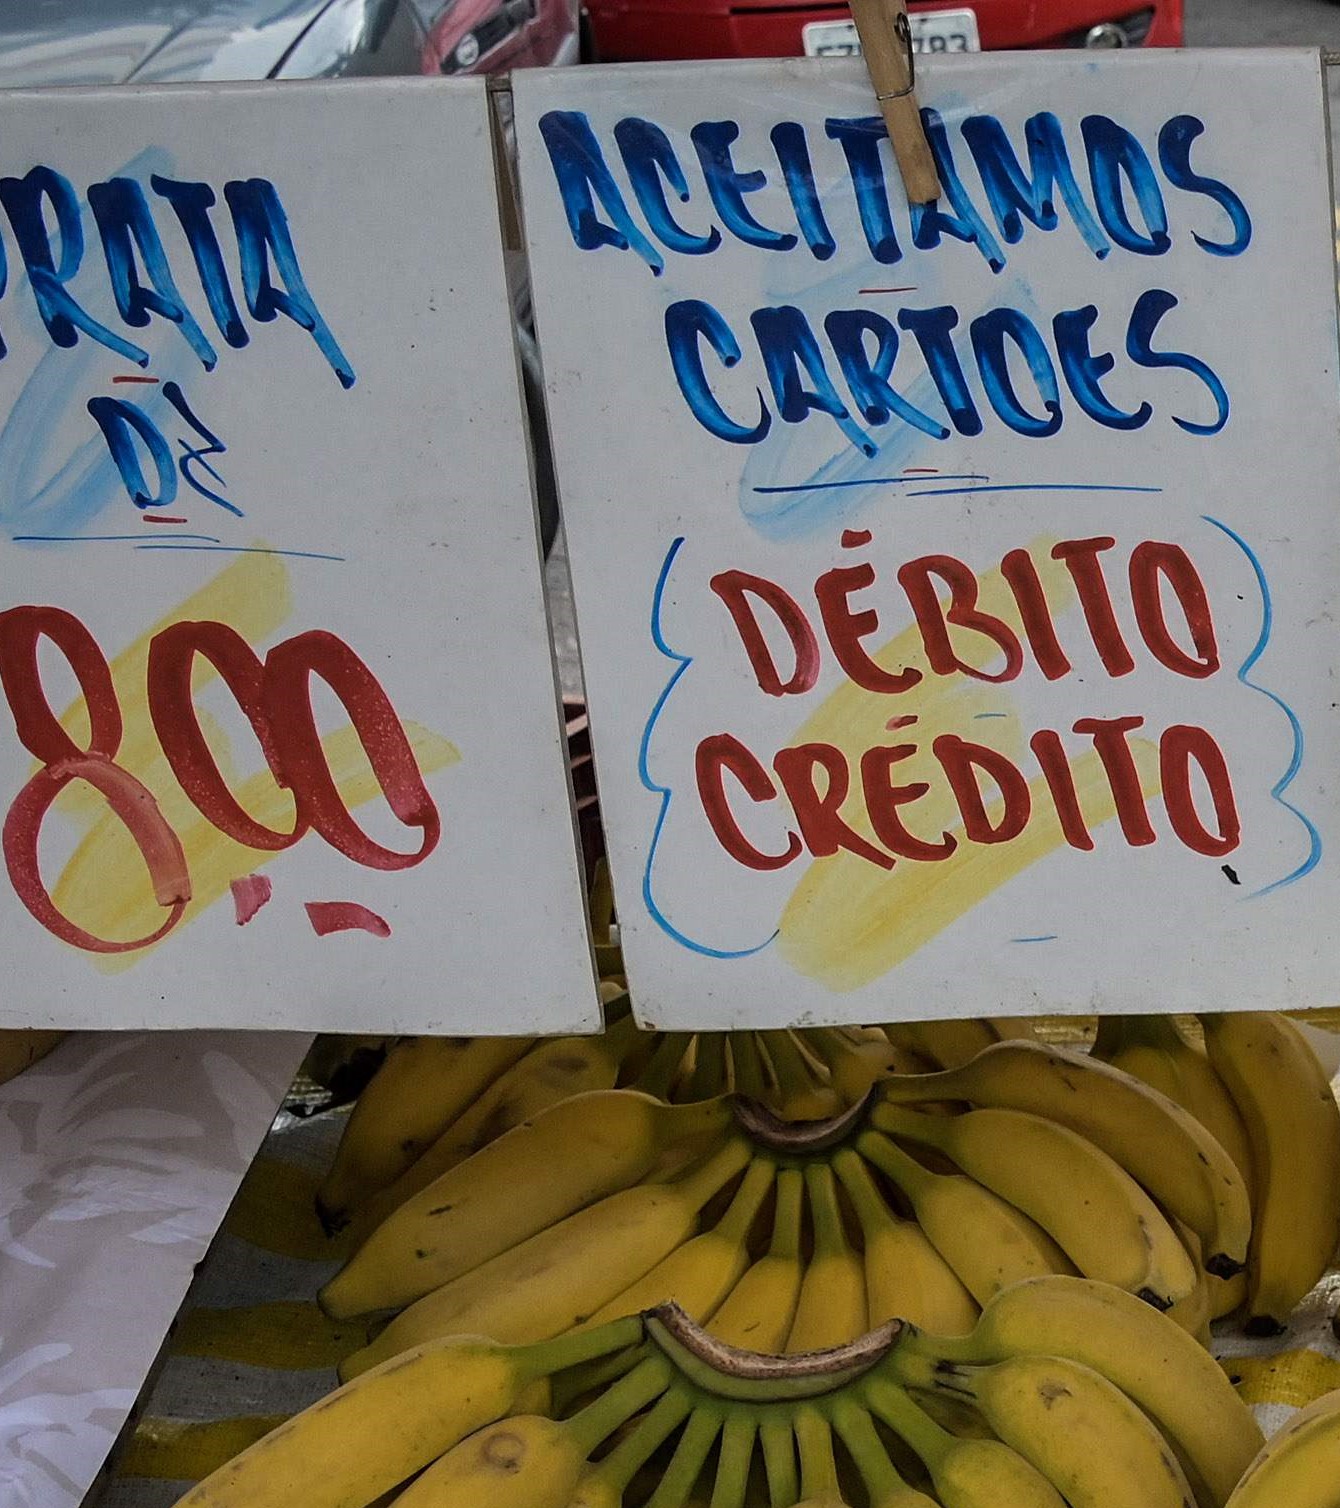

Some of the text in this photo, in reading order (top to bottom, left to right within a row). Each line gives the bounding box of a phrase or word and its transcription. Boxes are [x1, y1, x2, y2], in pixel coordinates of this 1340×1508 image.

[0, 164, 356, 388] RATA
[538, 107, 1252, 277] ACEITAMOS
[664, 289, 1229, 458] CARTOES
[710, 529, 1220, 696] DÉBITO
[694, 715, 1240, 870] CRÉDITO
